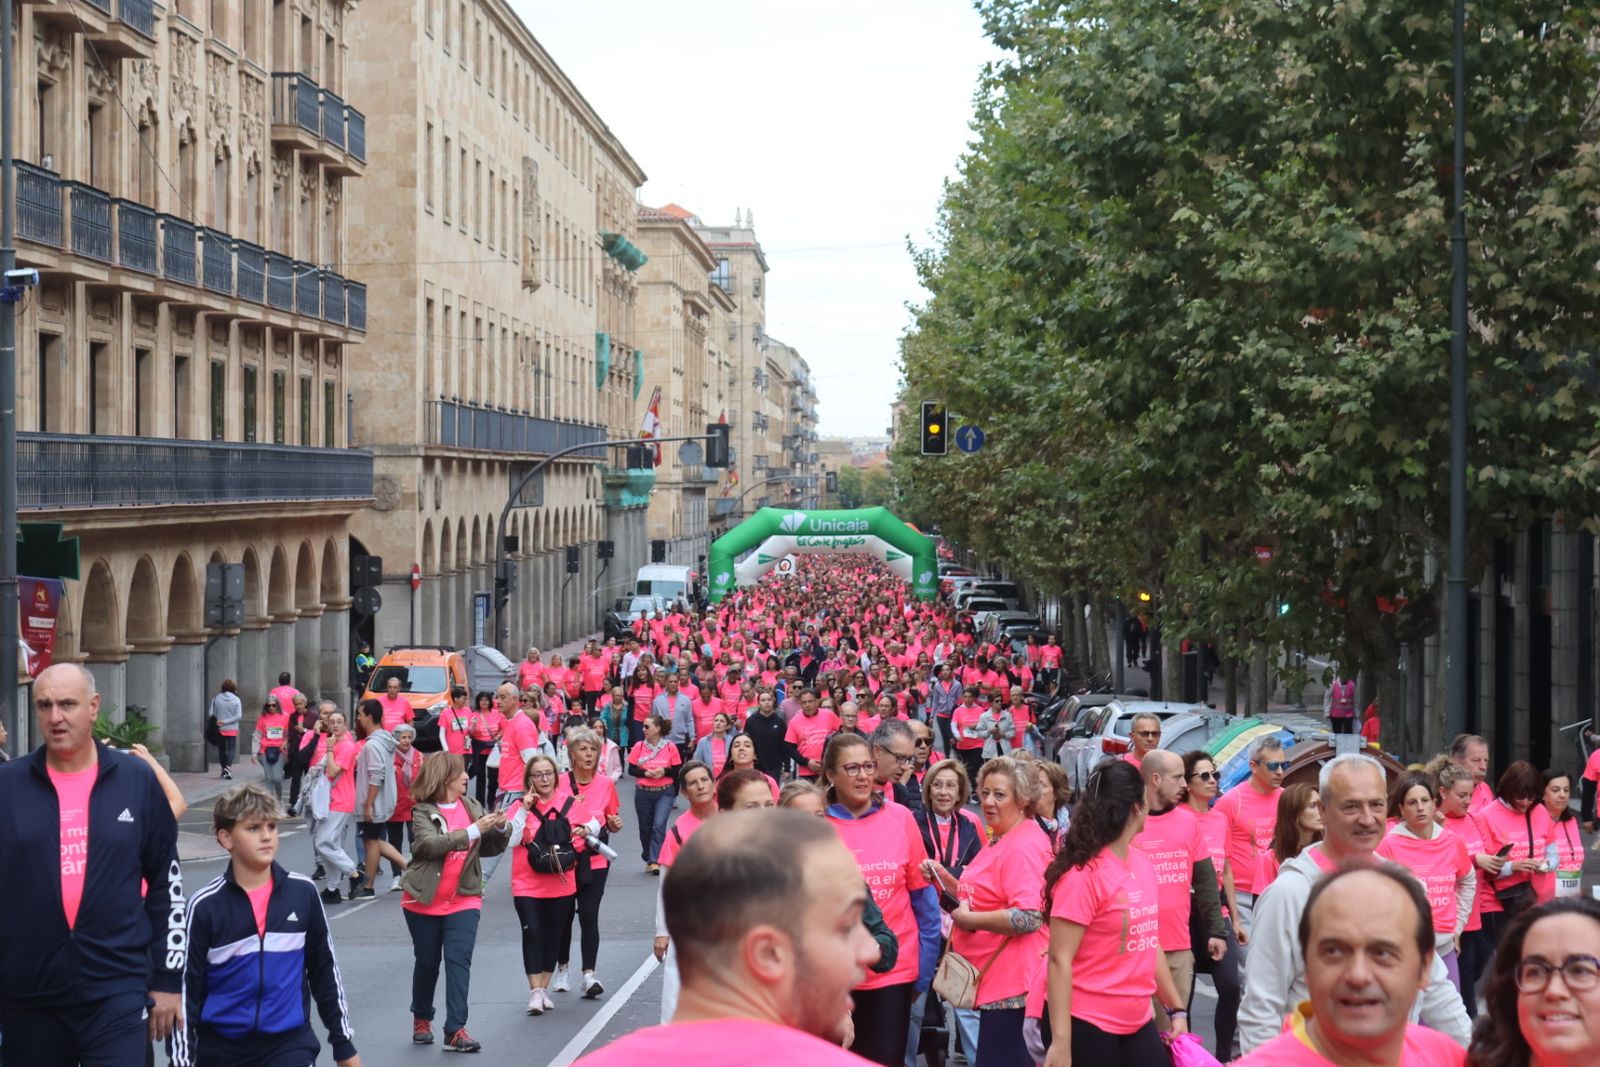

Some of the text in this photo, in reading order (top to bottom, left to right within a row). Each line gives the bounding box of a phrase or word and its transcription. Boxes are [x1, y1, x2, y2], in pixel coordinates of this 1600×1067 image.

[810, 517, 869, 533] Unicaja
[796, 534, 865, 549] El Corte Inglés
[165, 859, 187, 970] adidas
[1129, 906, 1142, 919] En
[1129, 919, 1158, 935] contra
